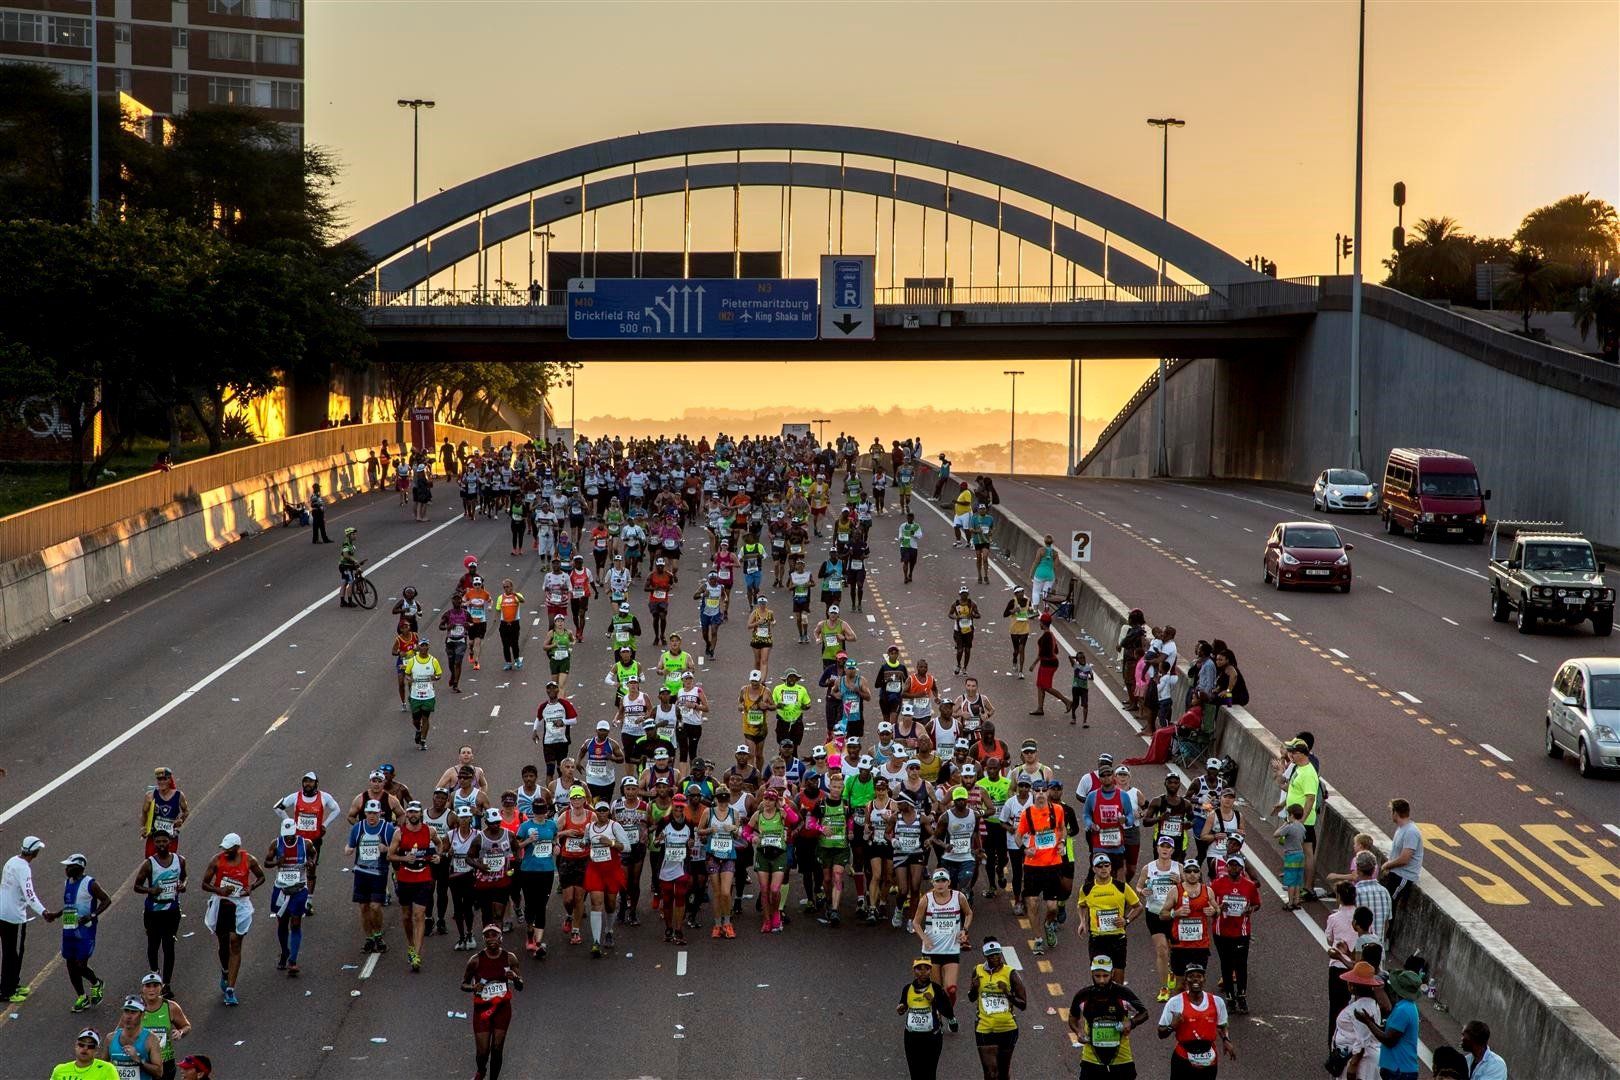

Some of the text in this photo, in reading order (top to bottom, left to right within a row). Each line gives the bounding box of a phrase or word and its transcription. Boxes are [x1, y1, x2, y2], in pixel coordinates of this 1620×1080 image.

[578, 281, 585, 290] 4
[575, 298, 593, 307] M10
[844, 289, 857, 305] R
[721, 299, 809, 311] Pietermaritzburg
[574, 310, 641, 321] Brickfield Rd
[755, 312, 772, 323] King
[775, 312, 799, 321] Shaka
[802, 312, 812, 321] Int
[619, 323, 652, 333] 500 m
